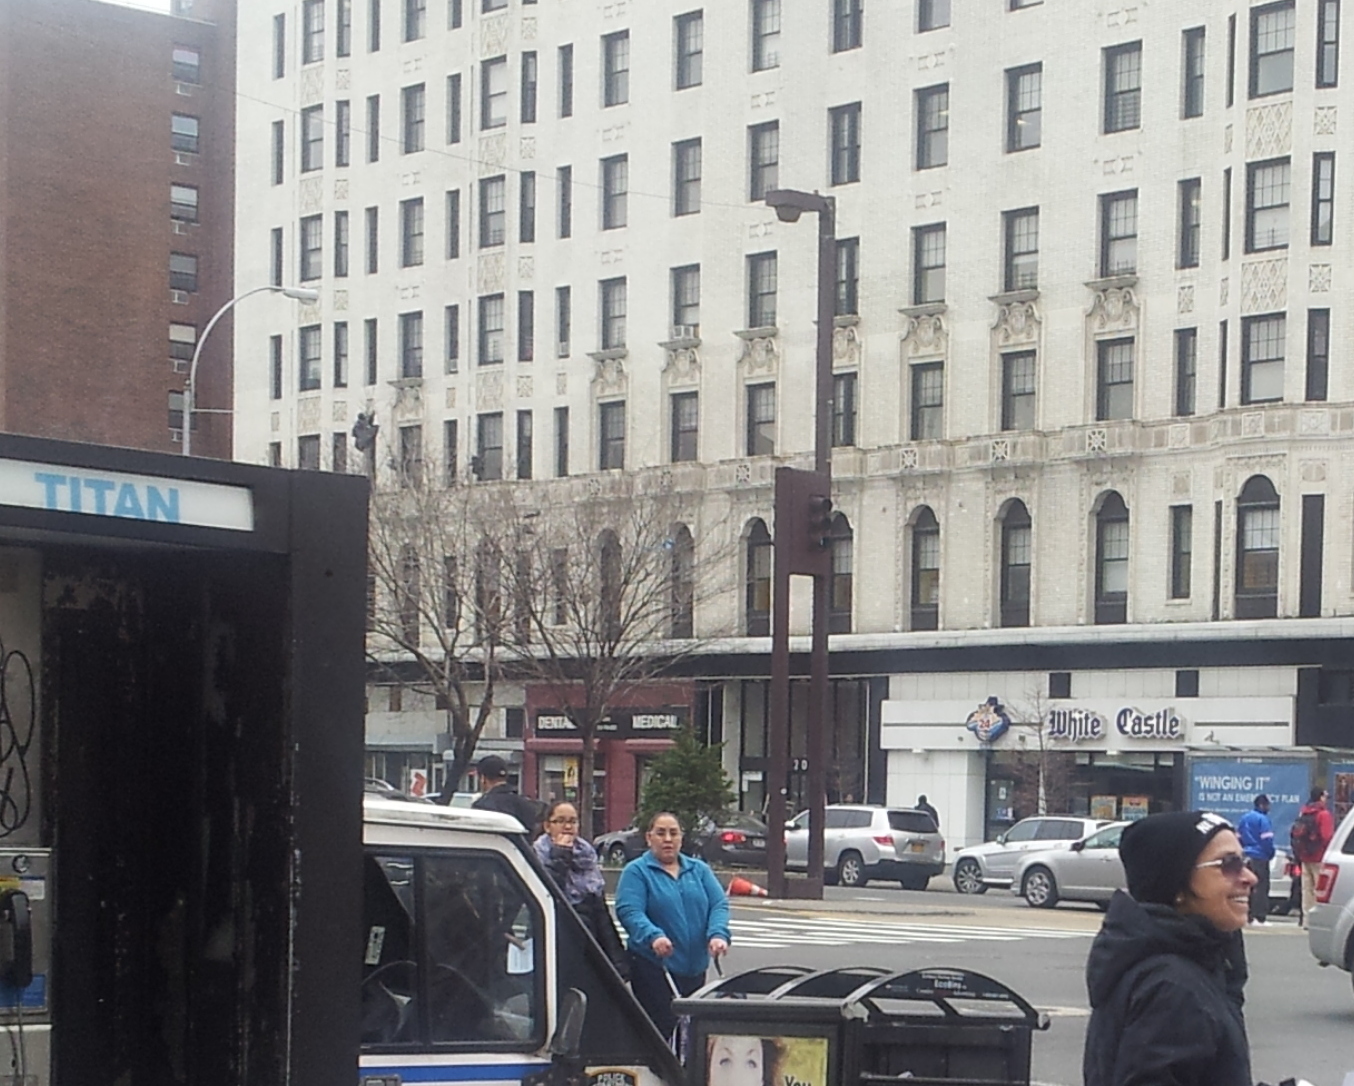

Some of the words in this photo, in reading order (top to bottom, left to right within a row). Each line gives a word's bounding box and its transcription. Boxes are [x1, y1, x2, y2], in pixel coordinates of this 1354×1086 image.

[35, 472, 180, 524] TITAN
[632, 714, 681, 729] MEDICAL
[1049, 708, 1102, 742] White
[1116, 706, 1181, 739] Castle
